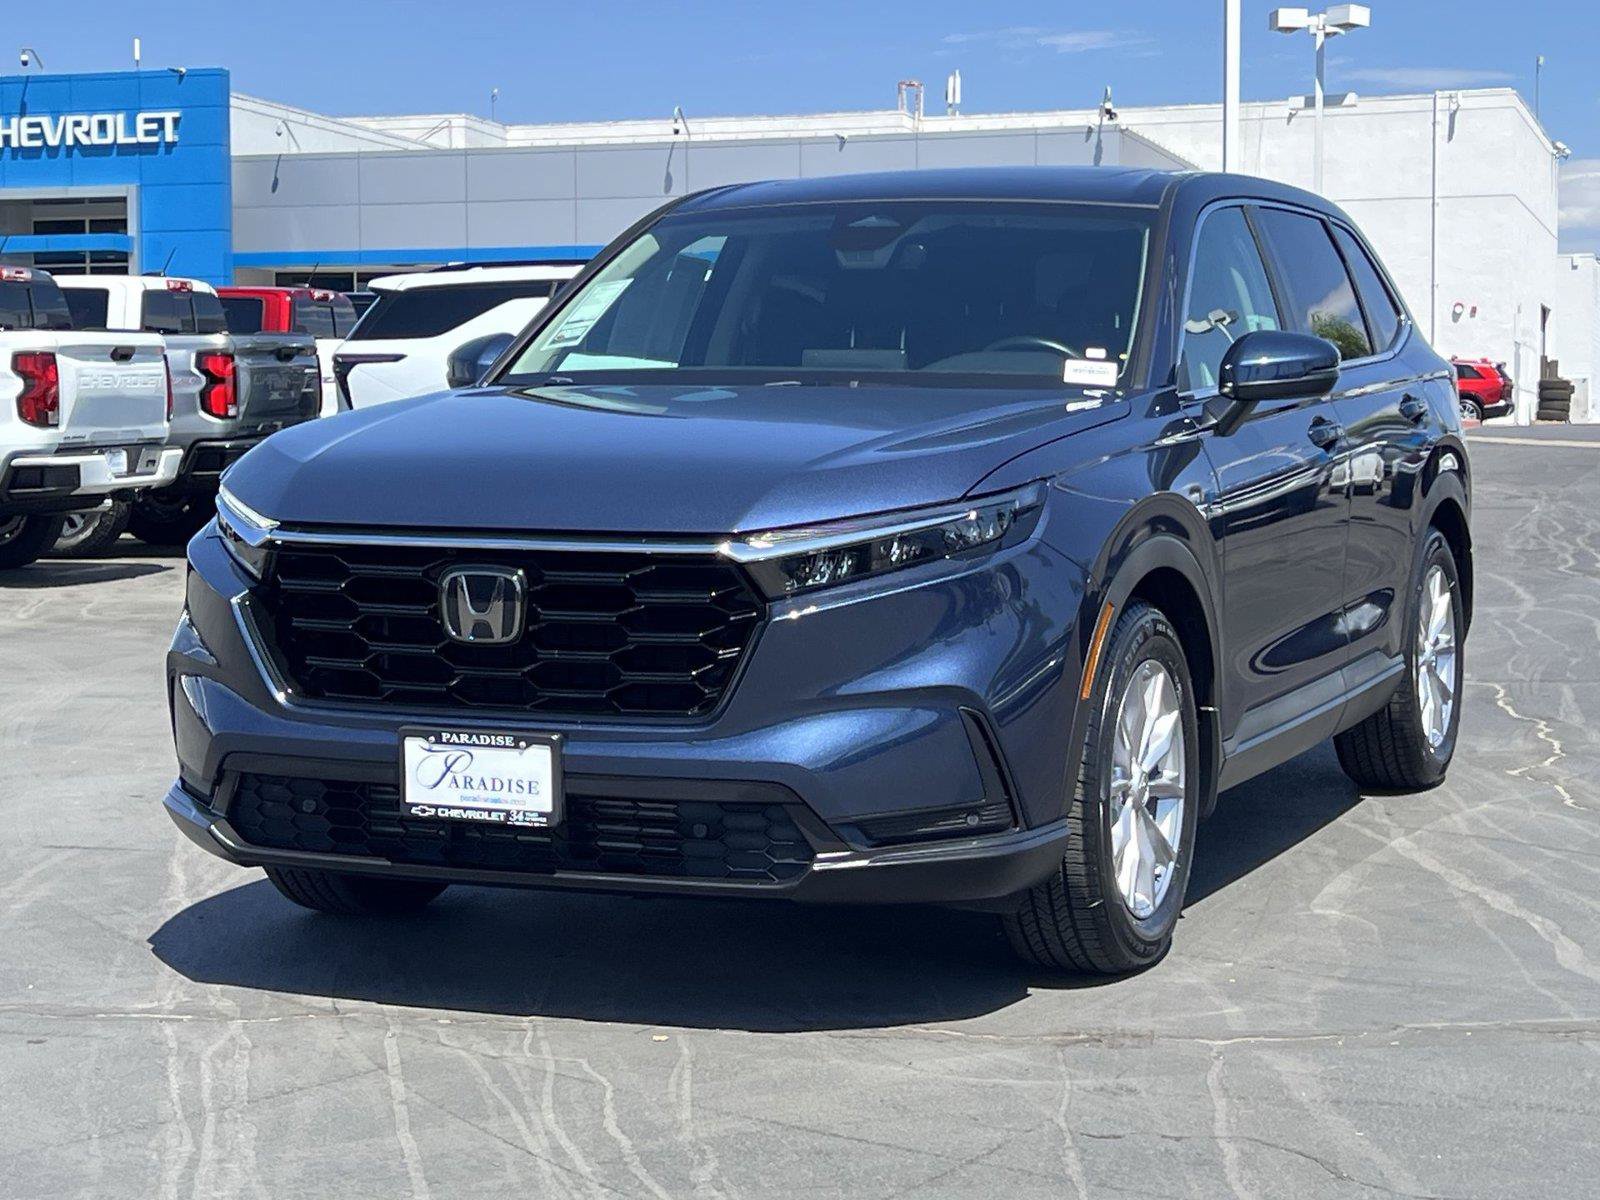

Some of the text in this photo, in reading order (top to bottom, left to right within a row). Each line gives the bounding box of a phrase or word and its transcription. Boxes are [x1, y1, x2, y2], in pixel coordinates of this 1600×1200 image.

[441, 732, 515, 747] PARADISE
[416, 744, 540, 795] PARADISE
[437, 807, 507, 822] CHEVROLET
[508, 809, 524, 822] 34
